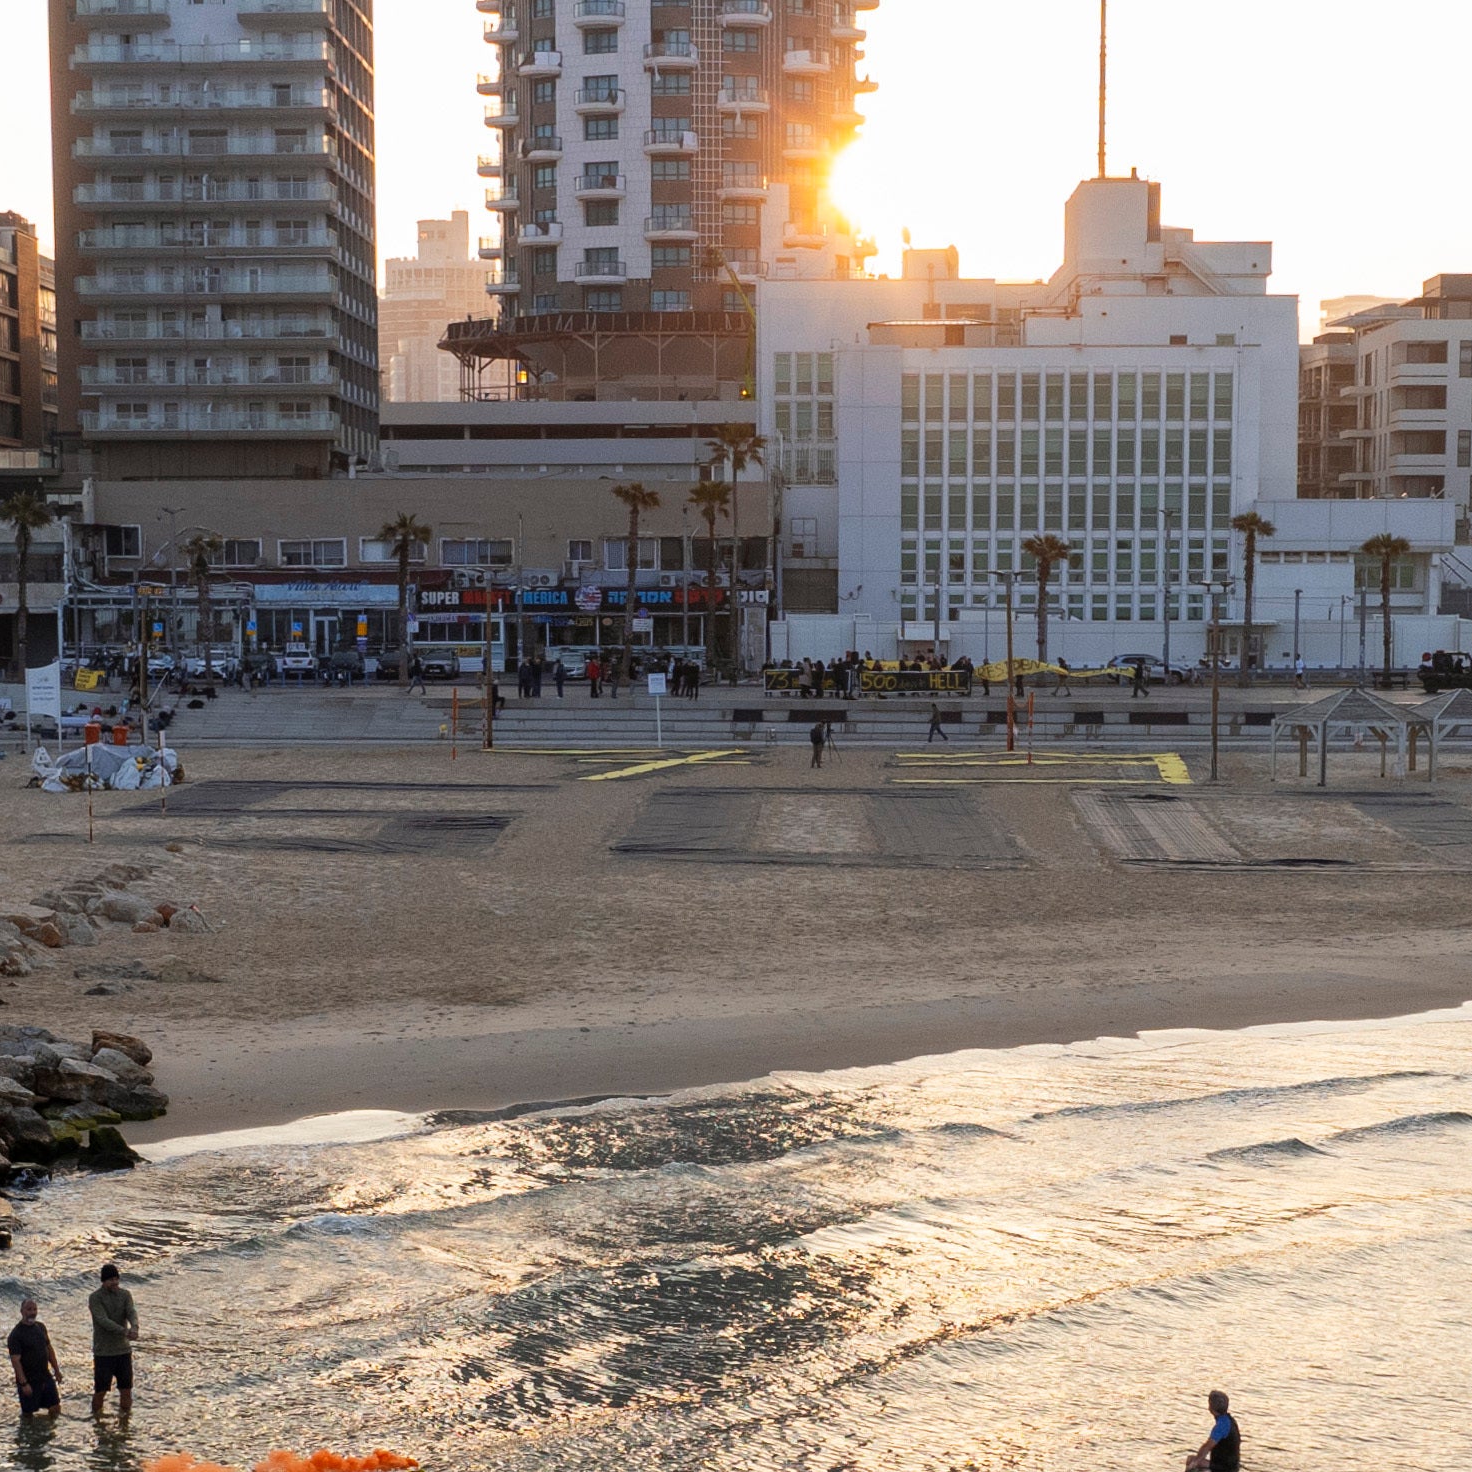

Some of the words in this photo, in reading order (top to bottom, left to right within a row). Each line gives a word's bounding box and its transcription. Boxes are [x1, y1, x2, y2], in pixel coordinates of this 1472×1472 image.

[421, 591, 460, 605] SUPER
[607, 591, 672, 605] אמרקה
[766, 671, 789, 690] 73
[860, 672, 897, 690] 500
